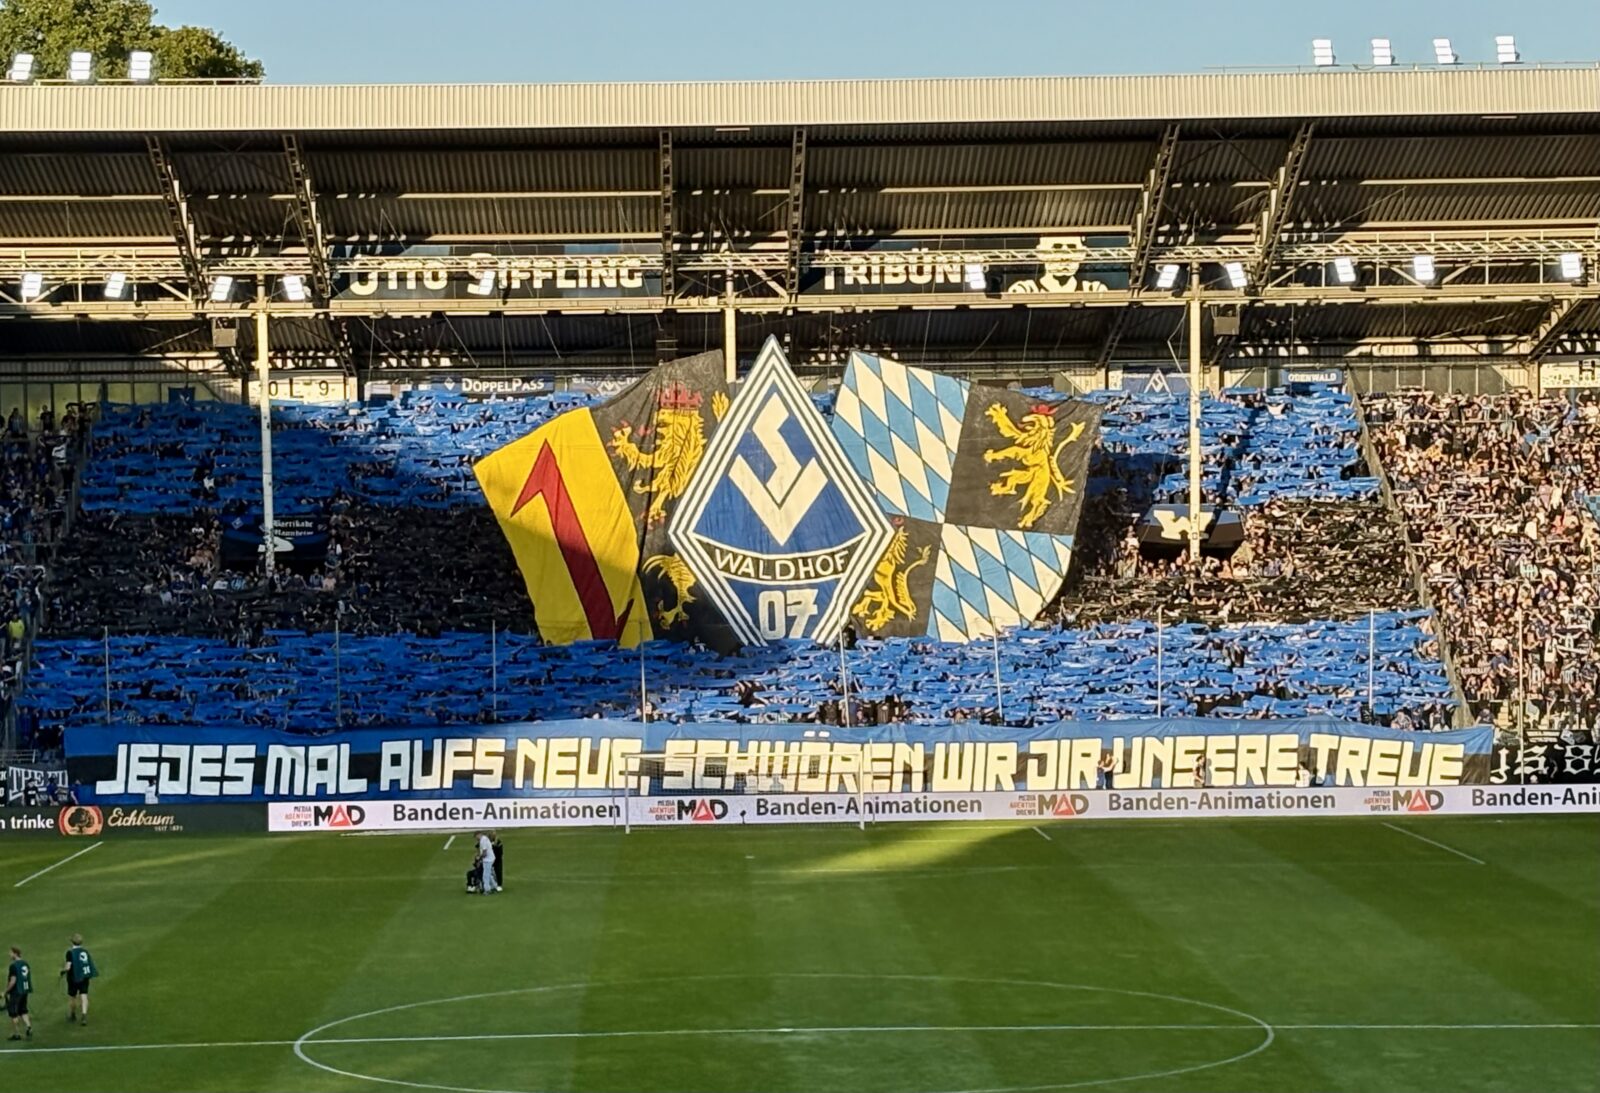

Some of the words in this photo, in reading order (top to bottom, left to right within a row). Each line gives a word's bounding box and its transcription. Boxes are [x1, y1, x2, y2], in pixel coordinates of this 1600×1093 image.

[715, 549, 850, 581] WALDHOF
[758, 588, 819, 640] 07
[95, 743, 257, 797] JEDES
[264, 743, 368, 797] MAL
[379, 738, 506, 791] AUFS
[662, 730, 925, 793] SCHWÖREN
[932, 741, 1018, 792] WIR
[1027, 738, 1102, 791] DIR
[1112, 733, 1301, 790] UNSERE
[1309, 733, 1465, 787] TREUE
[756, 796, 983, 816] Banden-Animationen
[1037, 793, 1090, 816] MAD
[1108, 790, 1337, 811] Banden-Animationen
[1392, 788, 1445, 811] MAD
[1472, 786, 1600, 807] Banden-Ani
[107, 807, 175, 827] Eichbaum
[313, 804, 366, 827] MAD
[393, 800, 622, 822] Banden-Animationen
[677, 799, 728, 821] MAD
[10, 814, 55, 830] trinke
